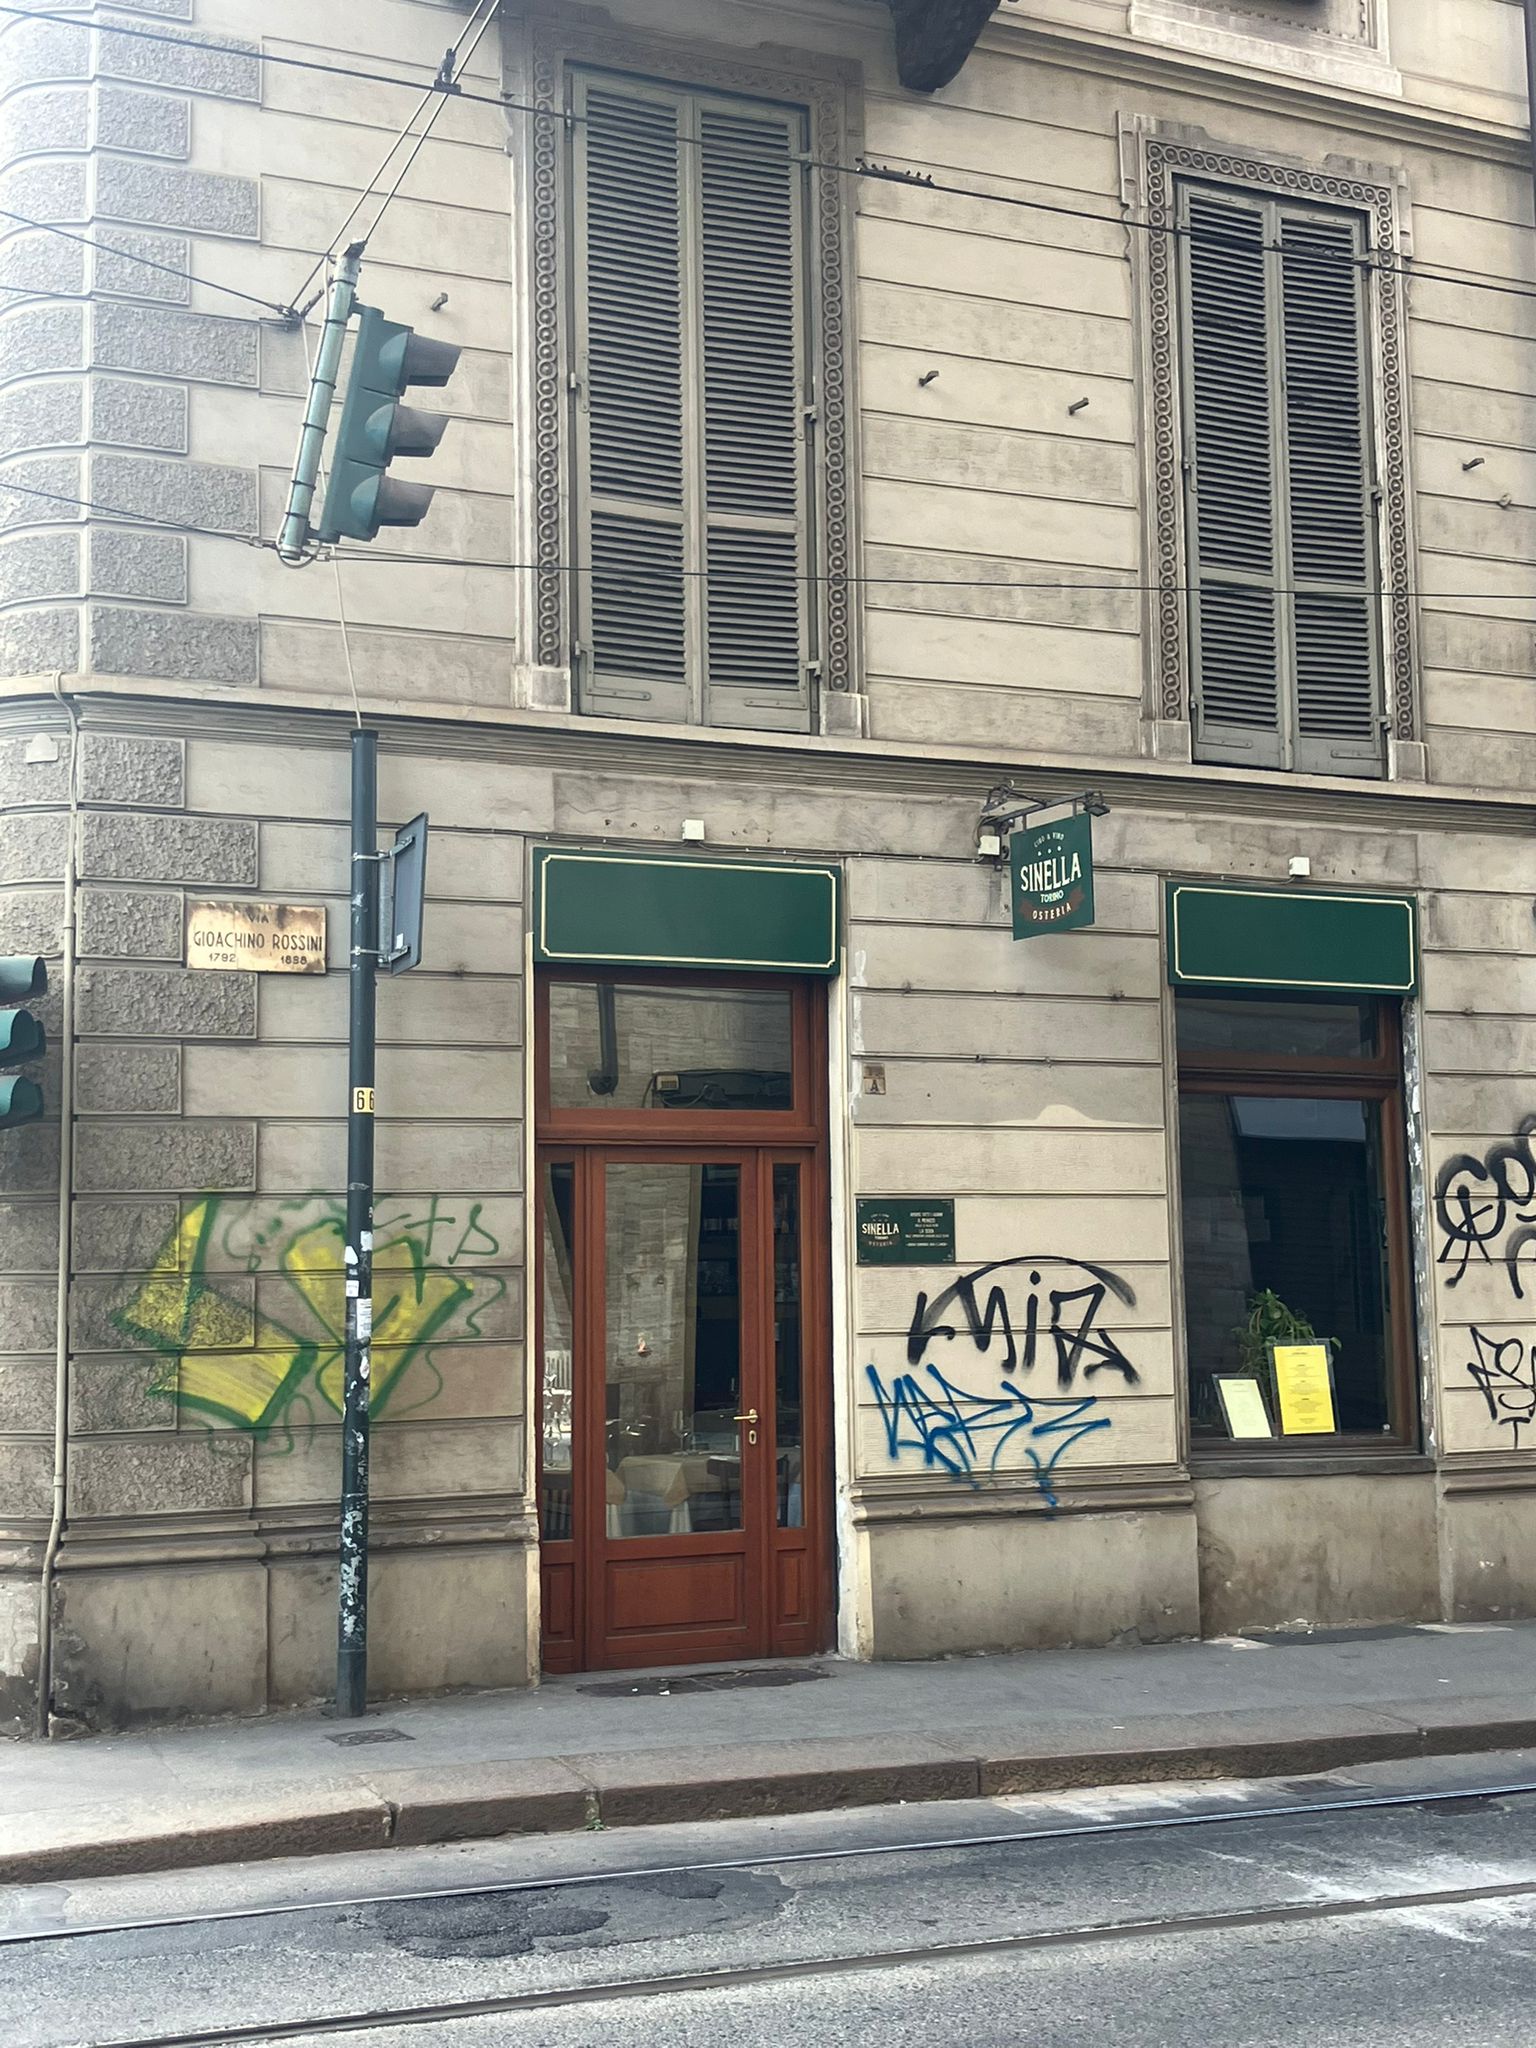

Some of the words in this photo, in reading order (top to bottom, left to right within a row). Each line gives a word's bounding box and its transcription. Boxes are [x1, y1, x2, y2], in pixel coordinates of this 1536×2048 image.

[1020, 852, 1082, 893] SINELLA
[1040, 889, 1065, 904] TORINO
[1032, 902, 1072, 920] OSTERIA
[246, 913, 269, 924] VIA
[193, 930, 265, 949] GIOACHINO
[272, 933, 323, 952] ROSSINI
[208, 952, 237, 963] 1792
[870, 1079, 879, 1092] A
[861, 1222, 900, 1236] SINELLA
